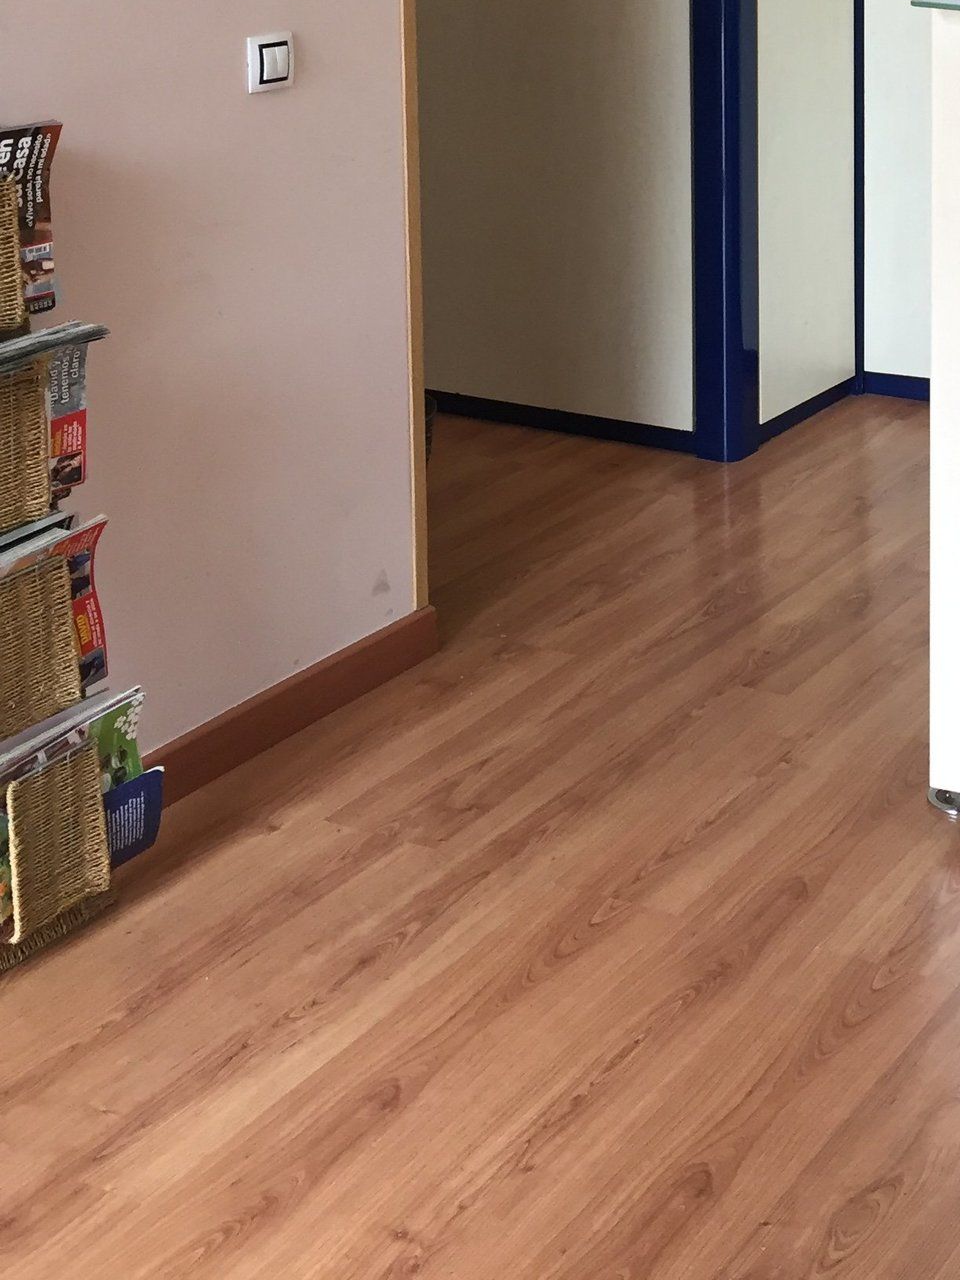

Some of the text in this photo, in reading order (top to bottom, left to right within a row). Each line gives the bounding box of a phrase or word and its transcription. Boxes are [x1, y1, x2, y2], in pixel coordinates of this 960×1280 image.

[27, 169, 35, 180] no
[35, 176, 44, 203] pareja
[60, 356, 70, 404] tenemos
